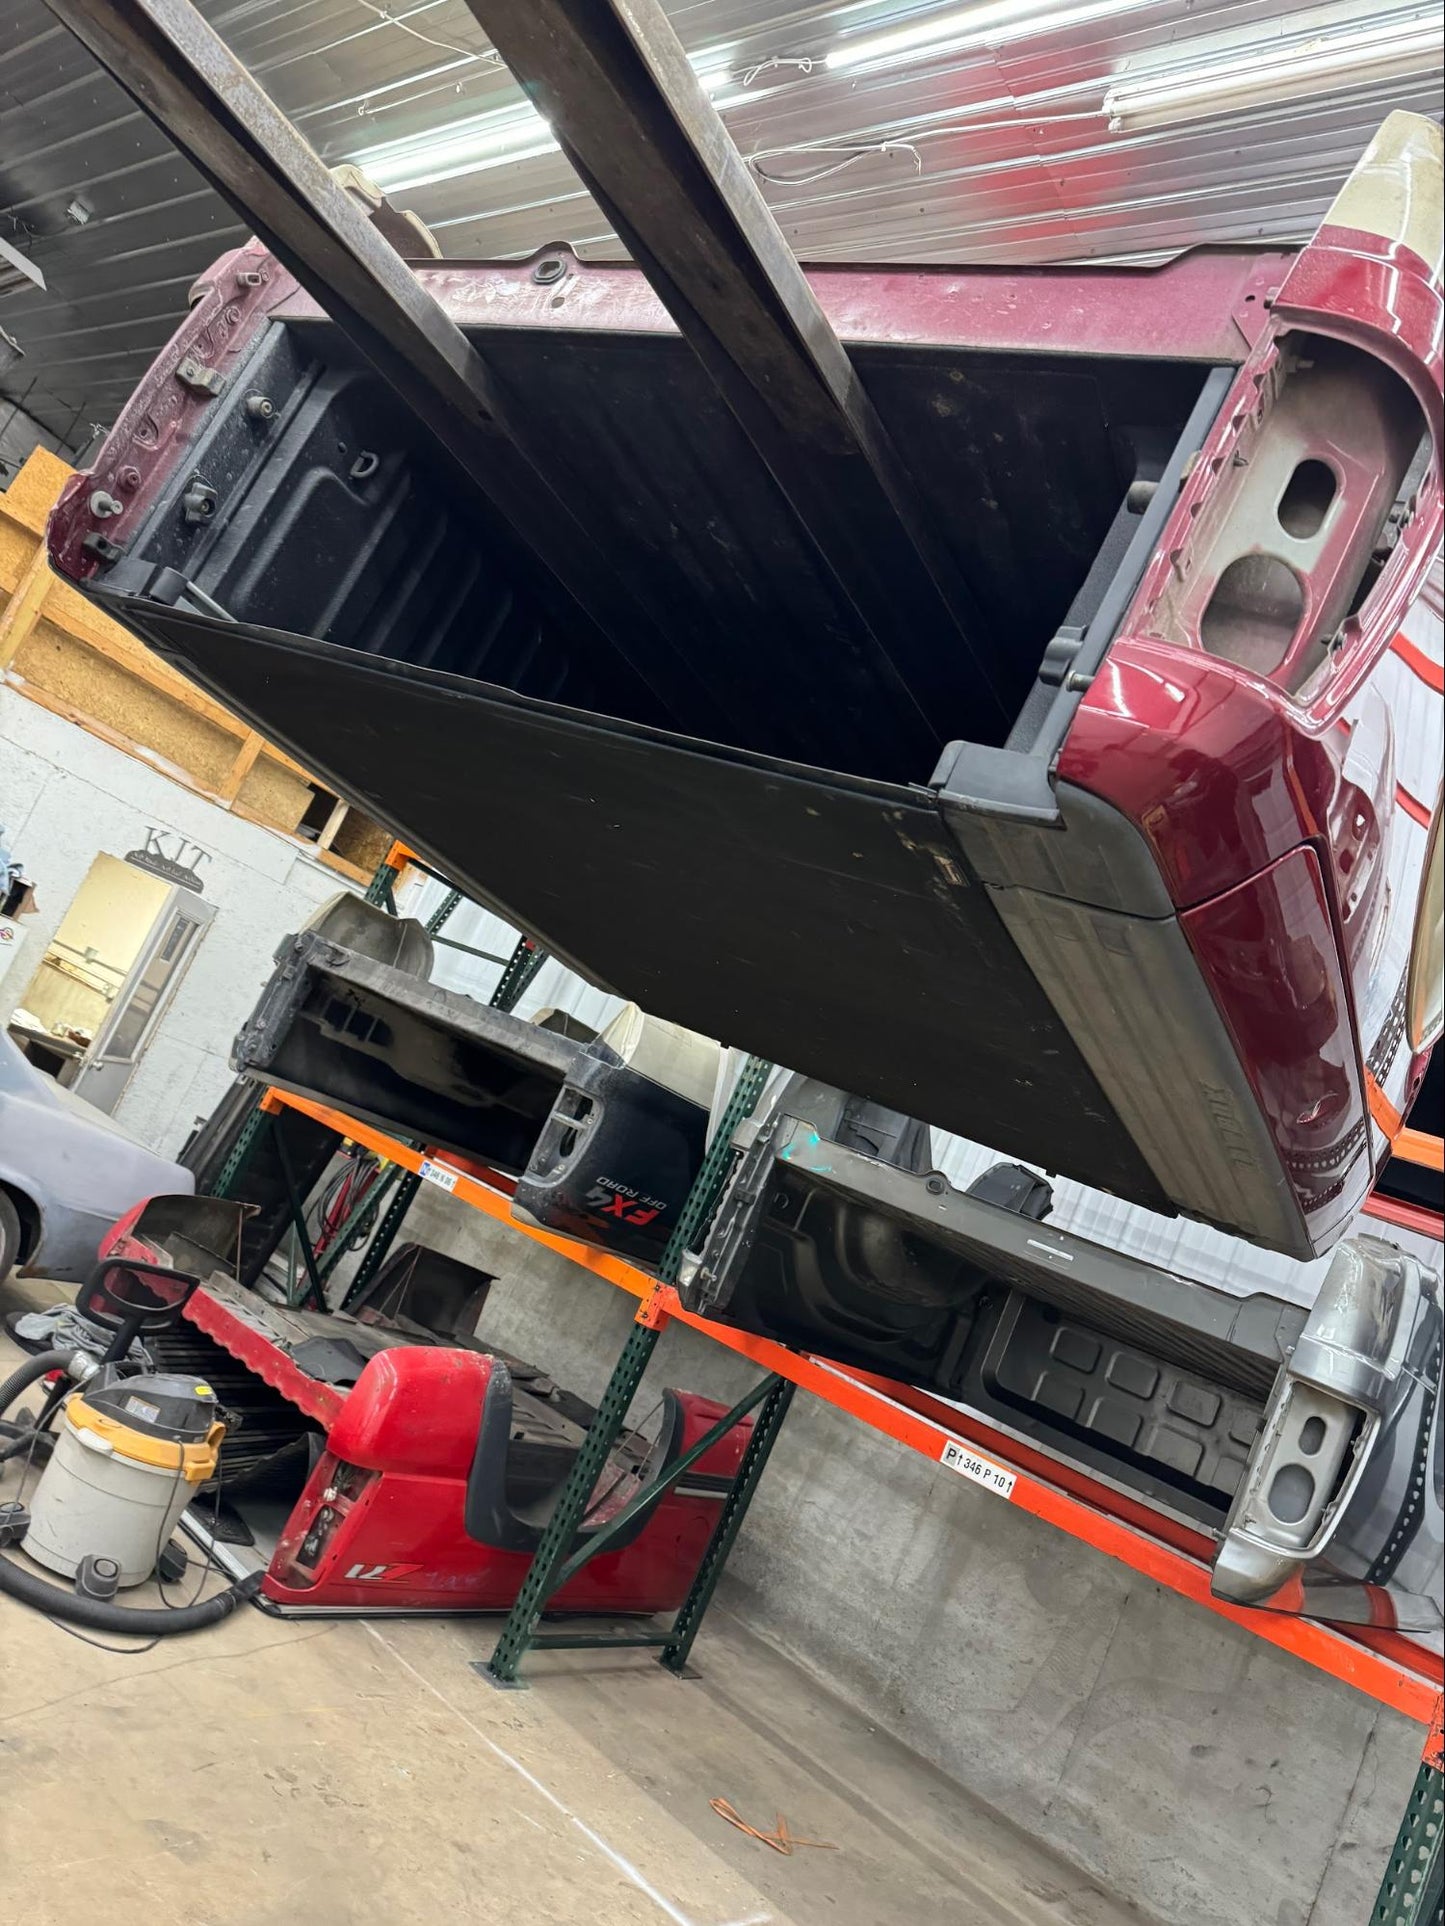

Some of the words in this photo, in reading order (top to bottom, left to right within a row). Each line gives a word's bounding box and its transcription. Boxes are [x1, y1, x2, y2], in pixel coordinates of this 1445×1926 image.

[144, 825, 213, 870] KIT
[596, 1176, 639, 1198] ROAD
[585, 1186, 660, 1226] FX4
[639, 1195, 668, 1211] OFF
[946, 1447, 957, 1460] P
[963, 1458, 982, 1475] 346
[983, 1468, 992, 1479] P
[993, 1474, 1006, 1488] 10
[344, 1562, 424, 1582] Z71
